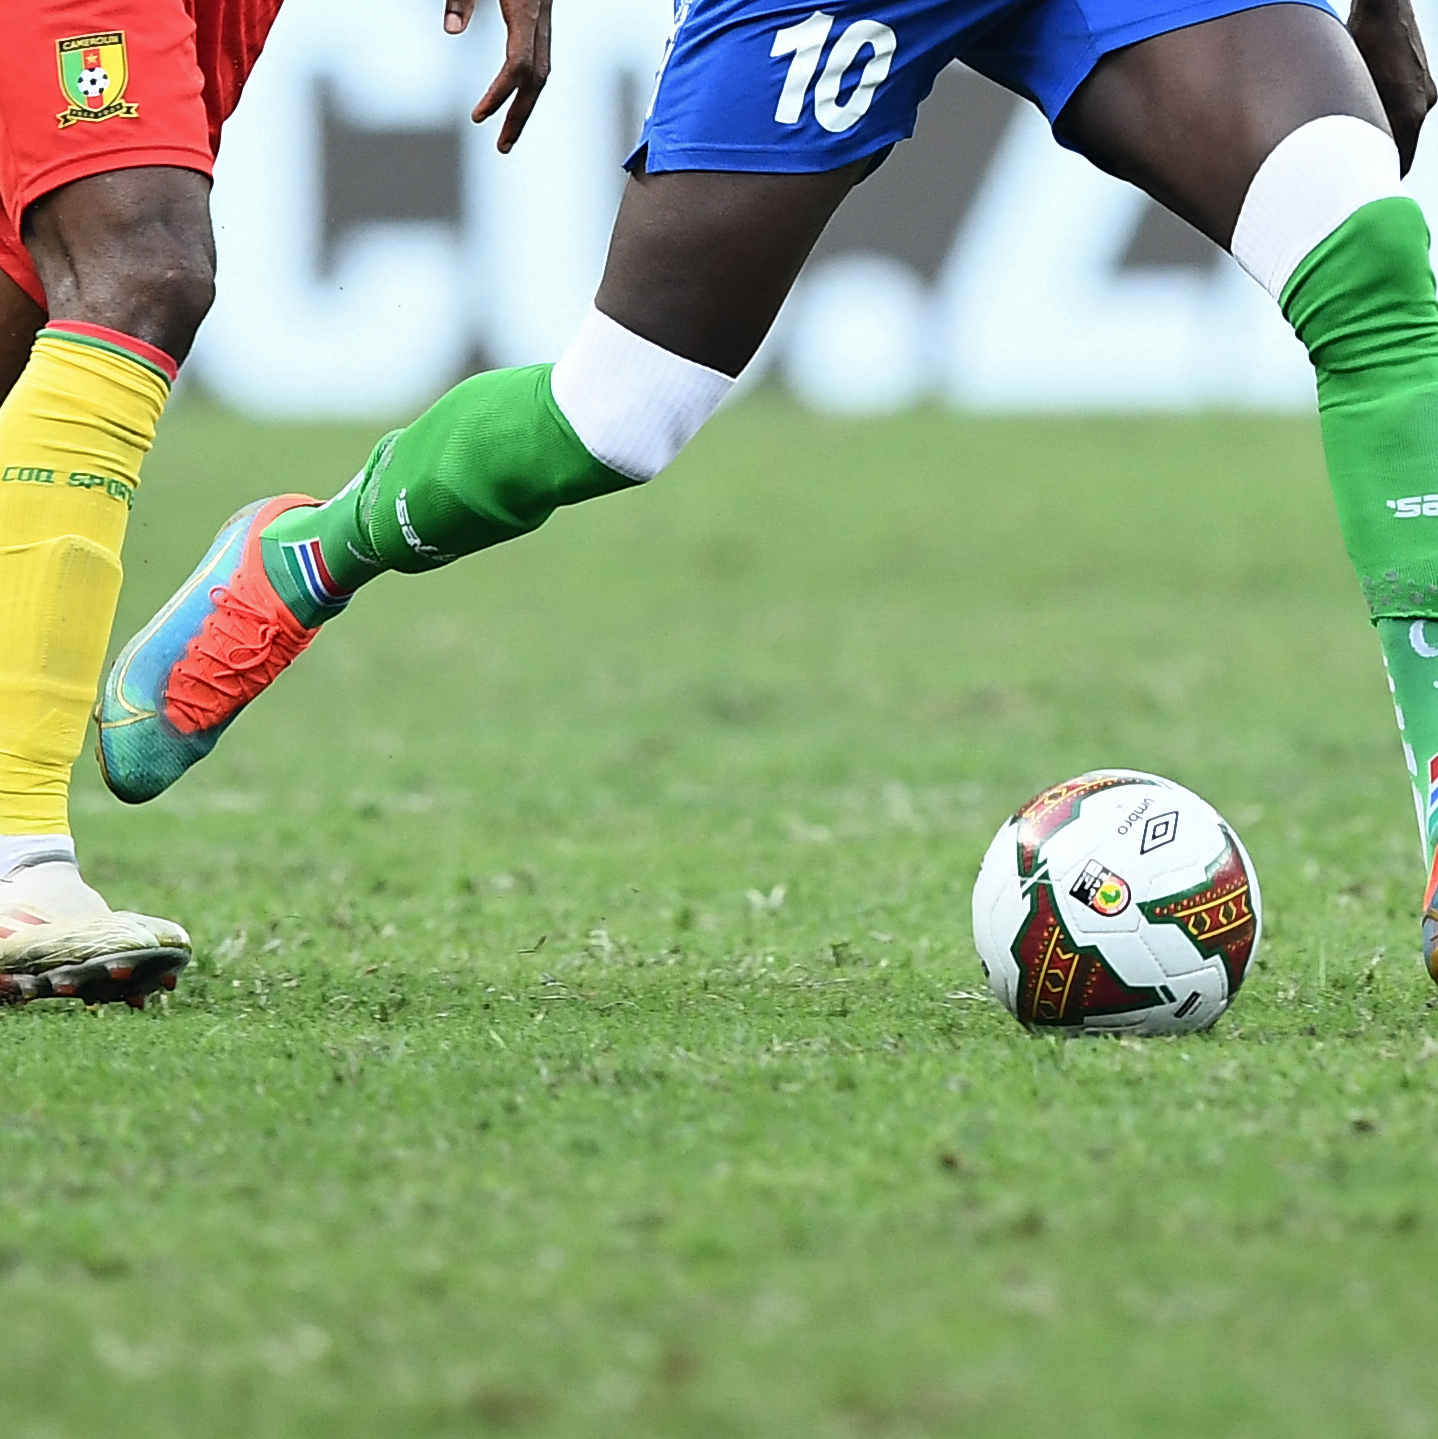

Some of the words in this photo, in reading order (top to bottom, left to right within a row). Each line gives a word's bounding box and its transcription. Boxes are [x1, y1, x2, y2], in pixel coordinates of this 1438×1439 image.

[62, 35, 120, 51] CAMEROUN
[769, 10, 897, 133] 10
[1117, 797, 1156, 836] umbro
